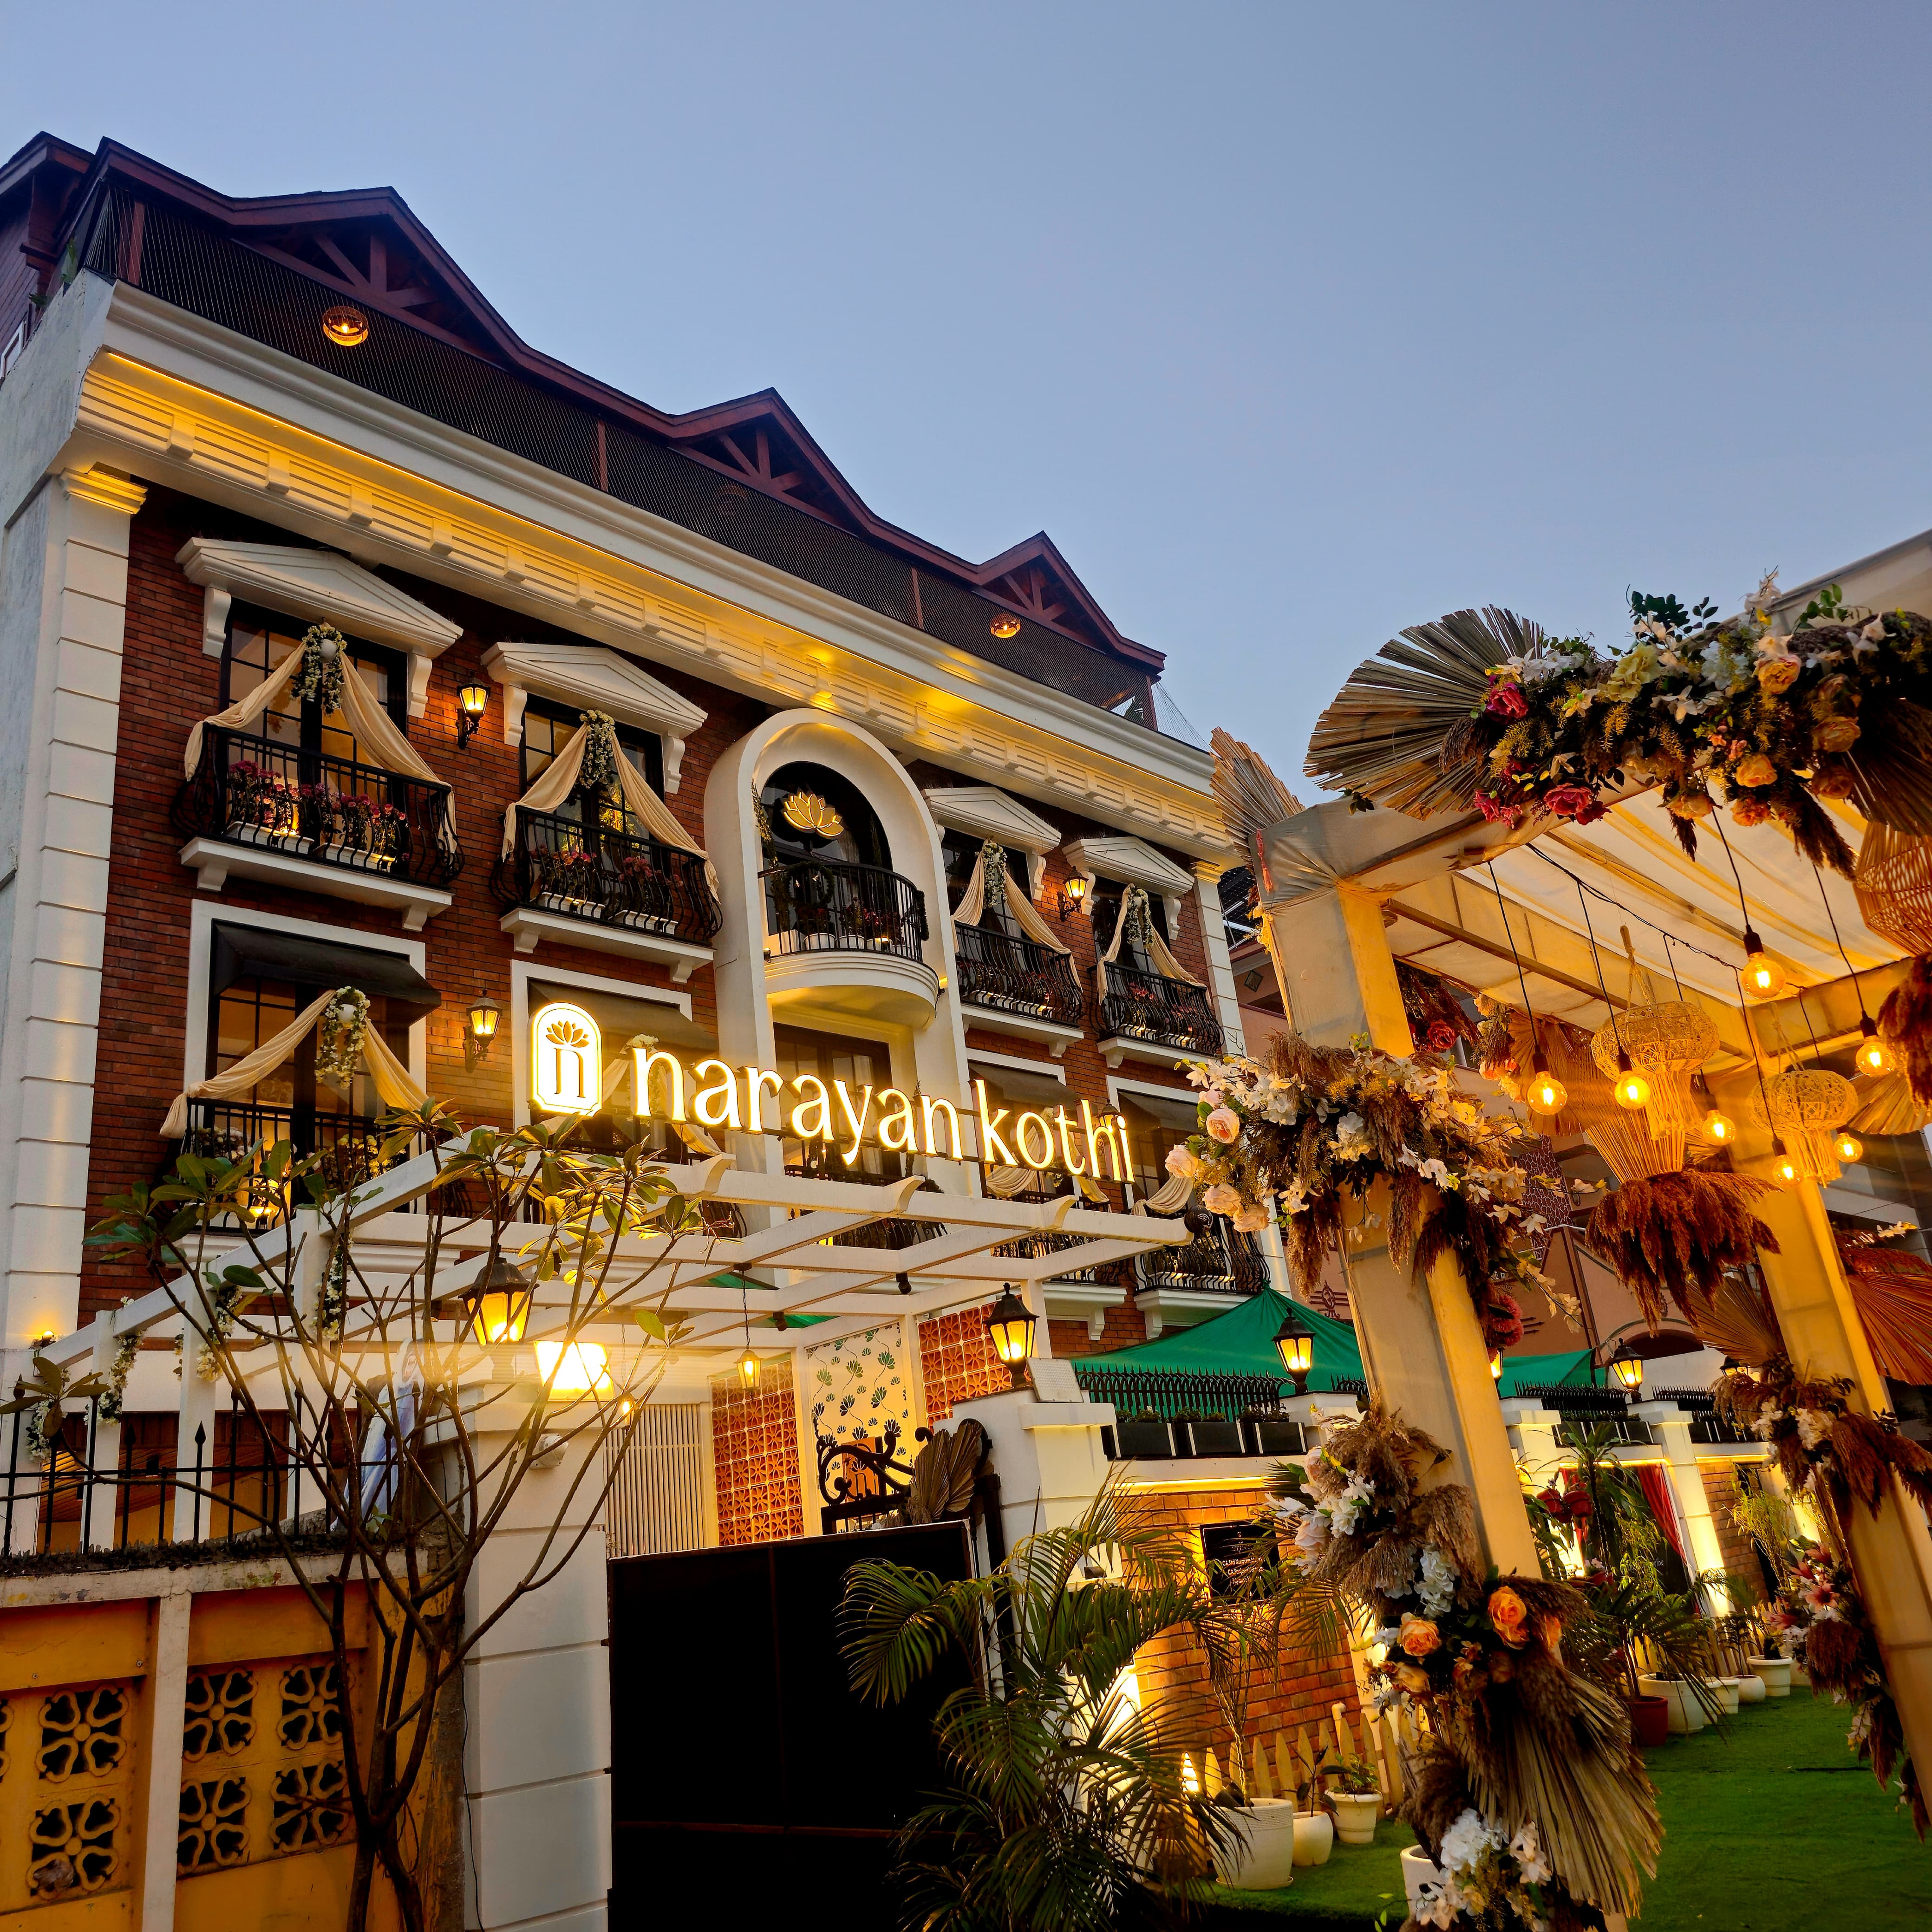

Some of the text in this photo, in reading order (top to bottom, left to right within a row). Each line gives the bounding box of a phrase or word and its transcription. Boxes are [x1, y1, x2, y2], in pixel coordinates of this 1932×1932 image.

[553, 1048, 586, 1098] n
[633, 1047, 1135, 1183] narayan kothi
